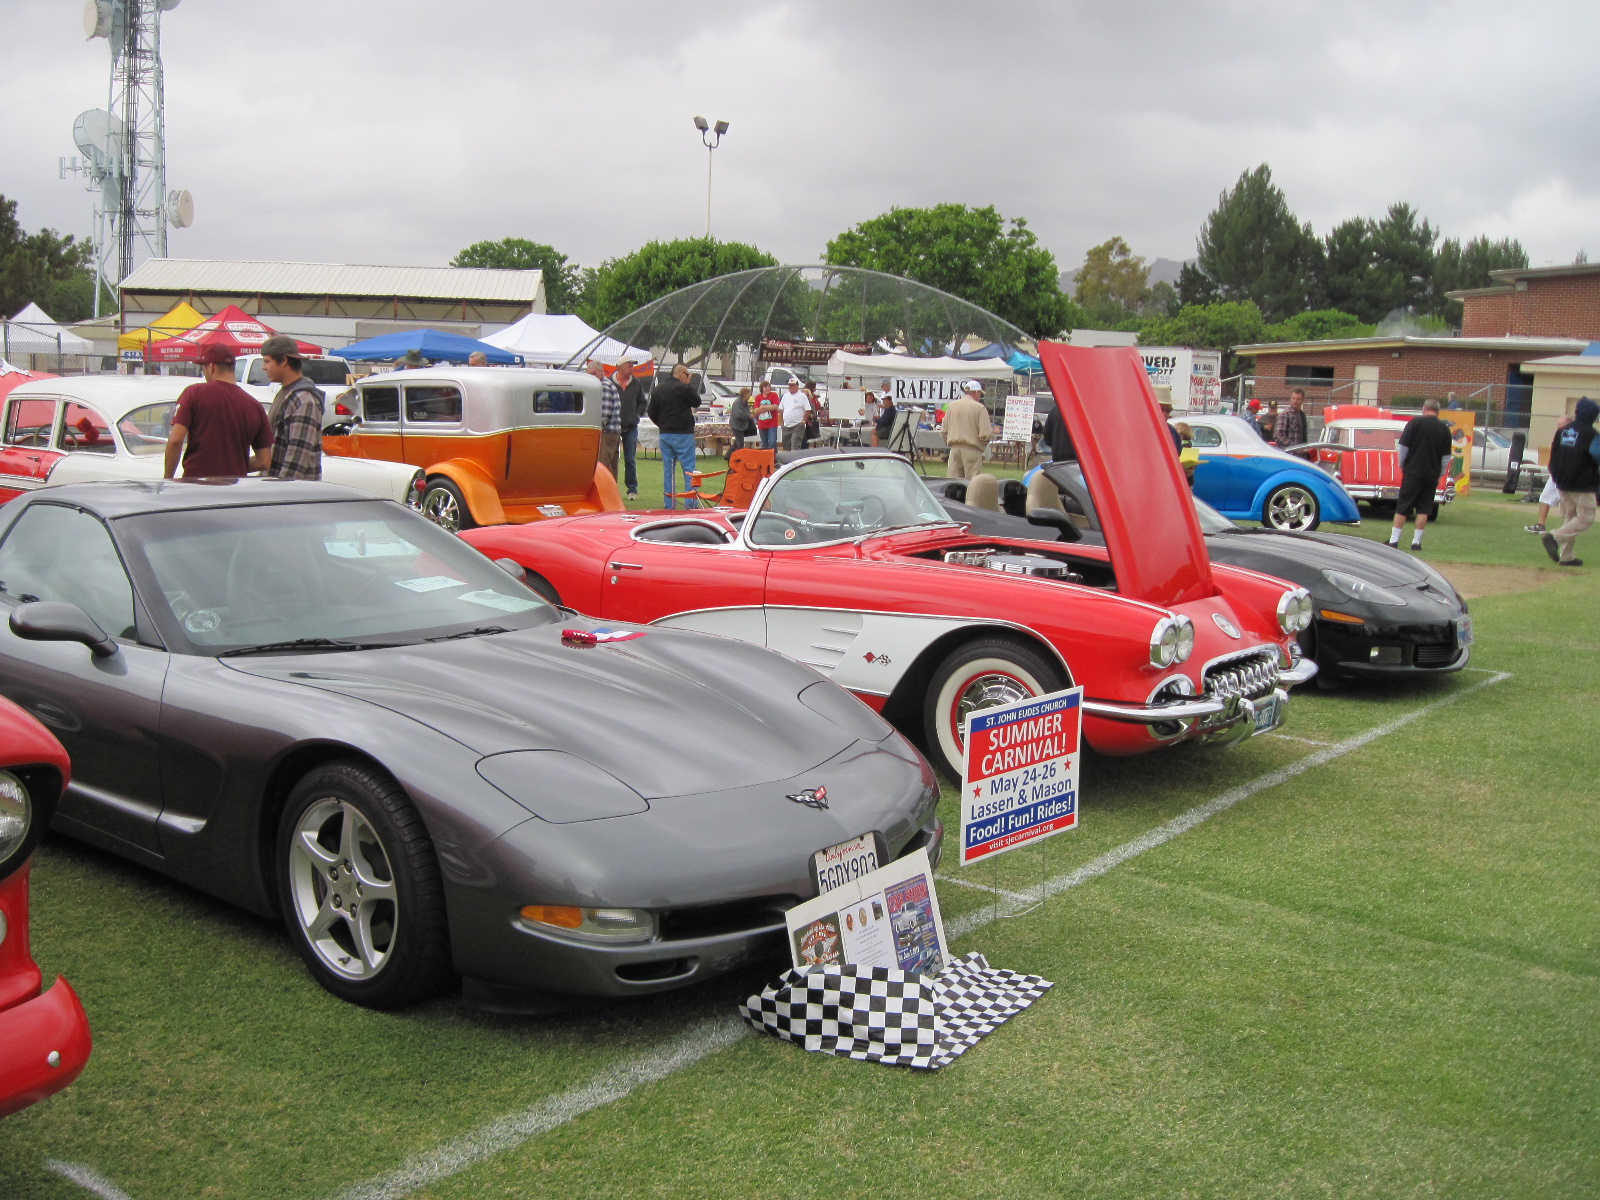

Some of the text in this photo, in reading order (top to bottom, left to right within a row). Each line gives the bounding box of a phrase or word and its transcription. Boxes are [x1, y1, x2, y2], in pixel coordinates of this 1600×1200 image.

[896, 379, 967, 400] RAFFLES
[986, 699, 1067, 727] ST. JOHN EUDES CHURCH
[989, 713, 1062, 751] SUMMER
[981, 733, 1067, 776] CARNIVAL!
[990, 762, 1057, 796] May 24-26
[971, 778, 1072, 820] Lassen & Mason
[969, 795, 1072, 843] Food! Fun! Rides!
[825, 843, 866, 862] California
[989, 823, 1054, 850] visit sjecarnival.org
